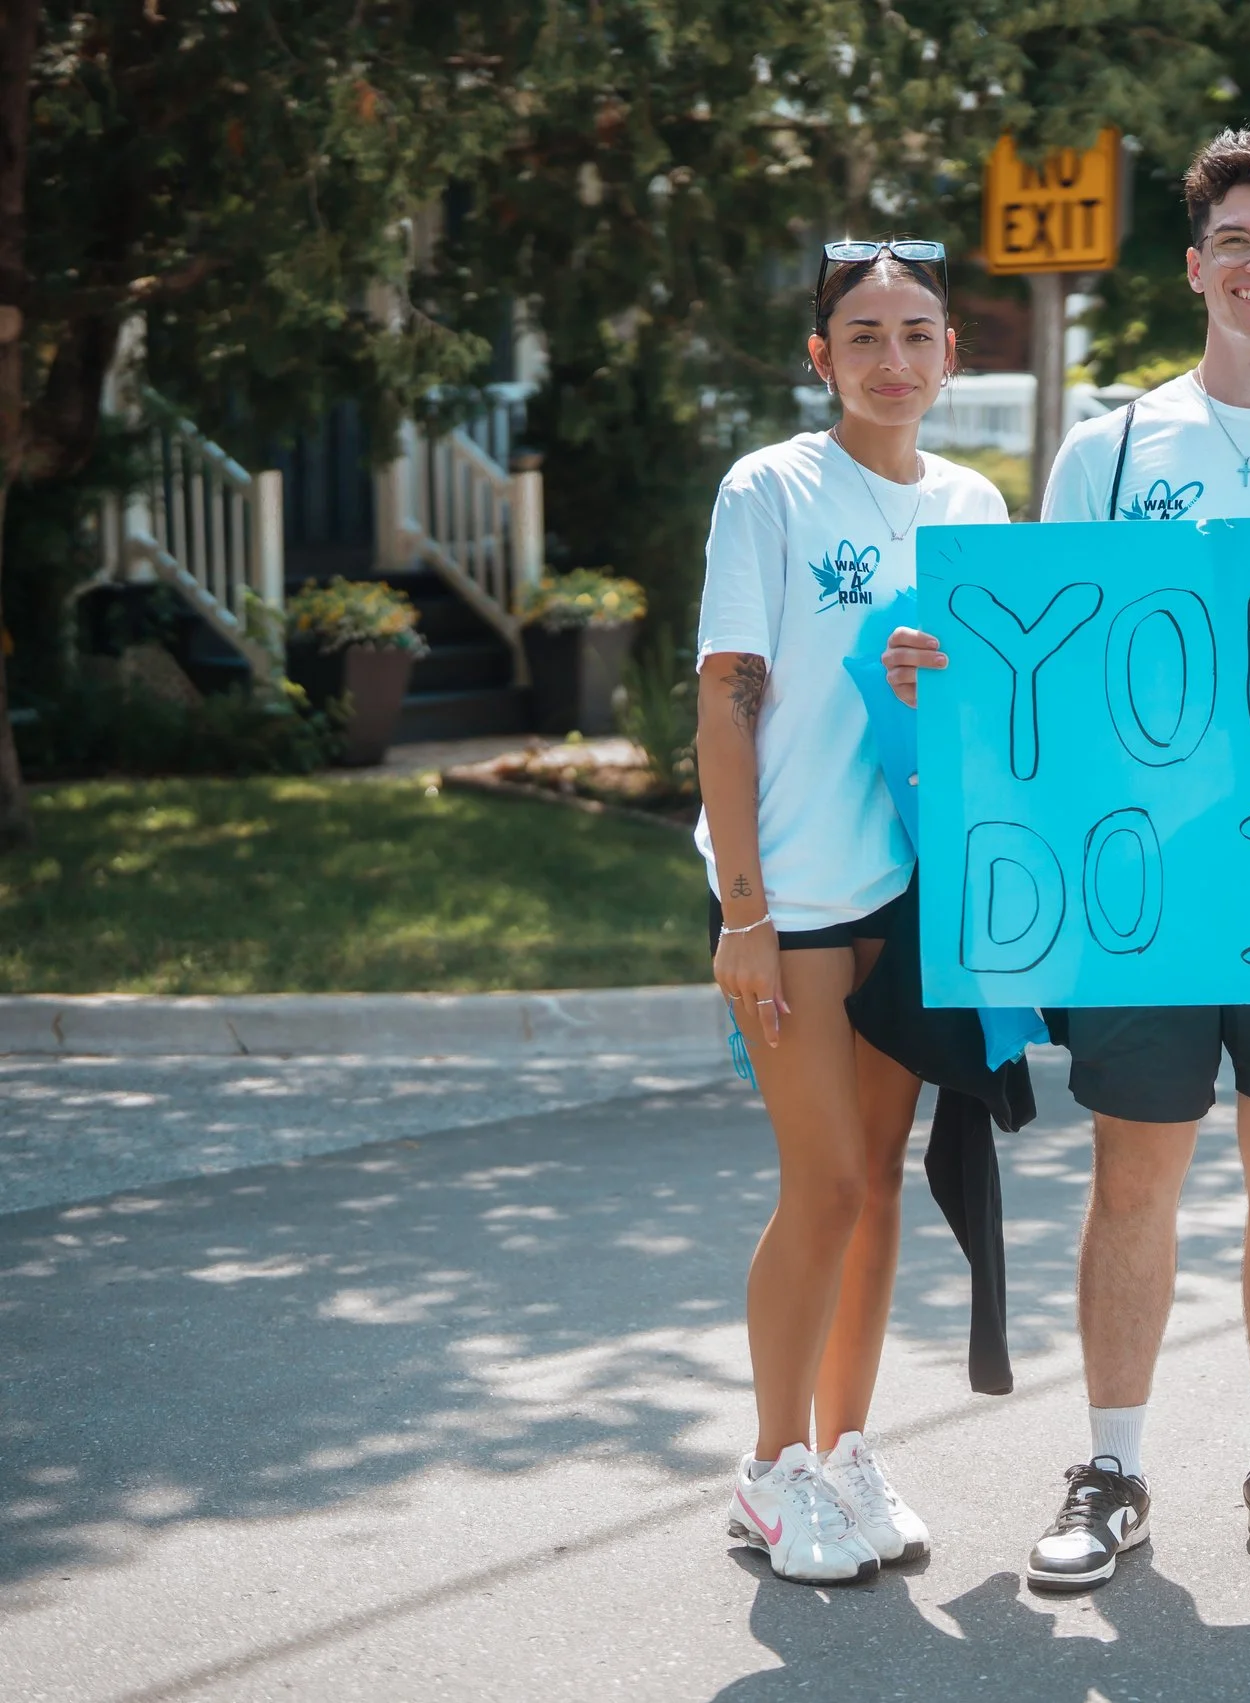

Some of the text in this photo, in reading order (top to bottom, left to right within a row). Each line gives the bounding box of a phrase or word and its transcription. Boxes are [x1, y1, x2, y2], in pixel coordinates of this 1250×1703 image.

[1002, 199, 1100, 256] EXIT
[1144, 499, 1184, 511] WALK
[835, 560, 870, 573] WALK
[850, 571, 864, 591] 4
[838, 591, 873, 605] RONI
[959, 807, 1164, 973] DO
